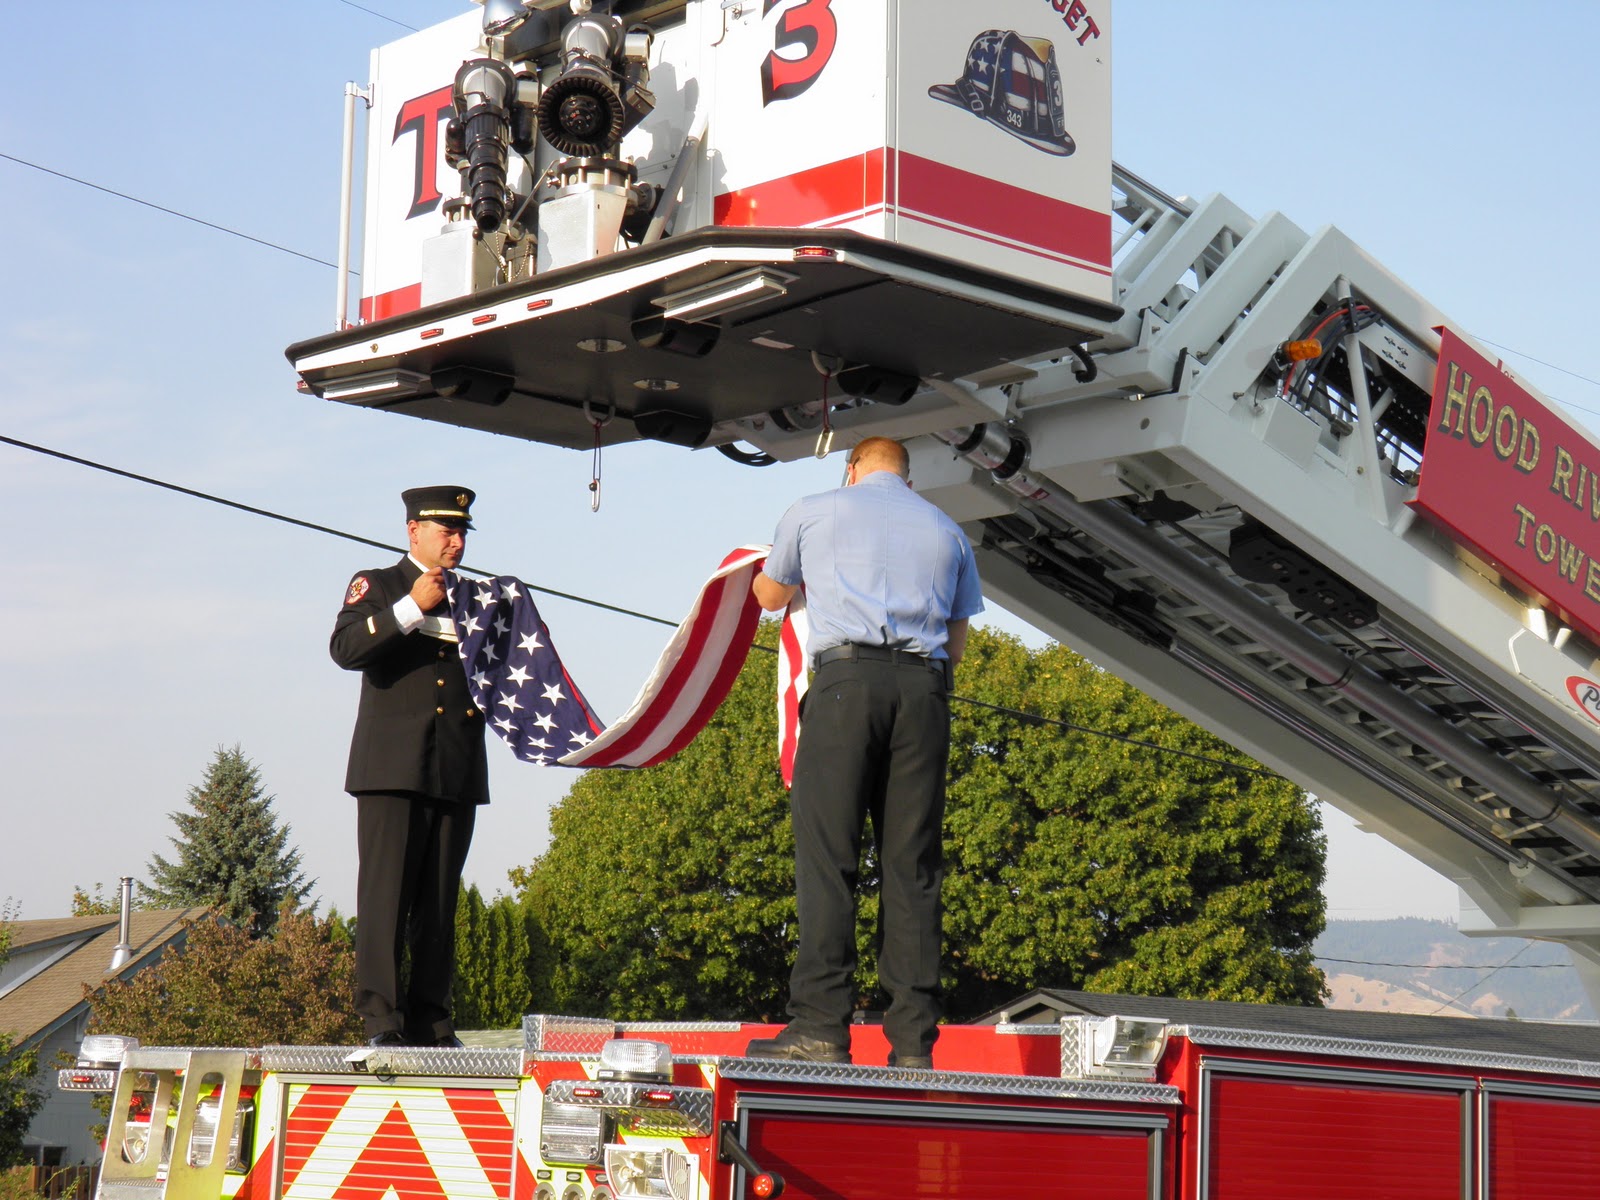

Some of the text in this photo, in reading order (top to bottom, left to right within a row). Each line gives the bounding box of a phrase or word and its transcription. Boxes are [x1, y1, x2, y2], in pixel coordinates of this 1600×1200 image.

[761, 0, 837, 108] 3
[1006, 109, 1022, 128] 343
[1439, 361, 1540, 475] HOOD
